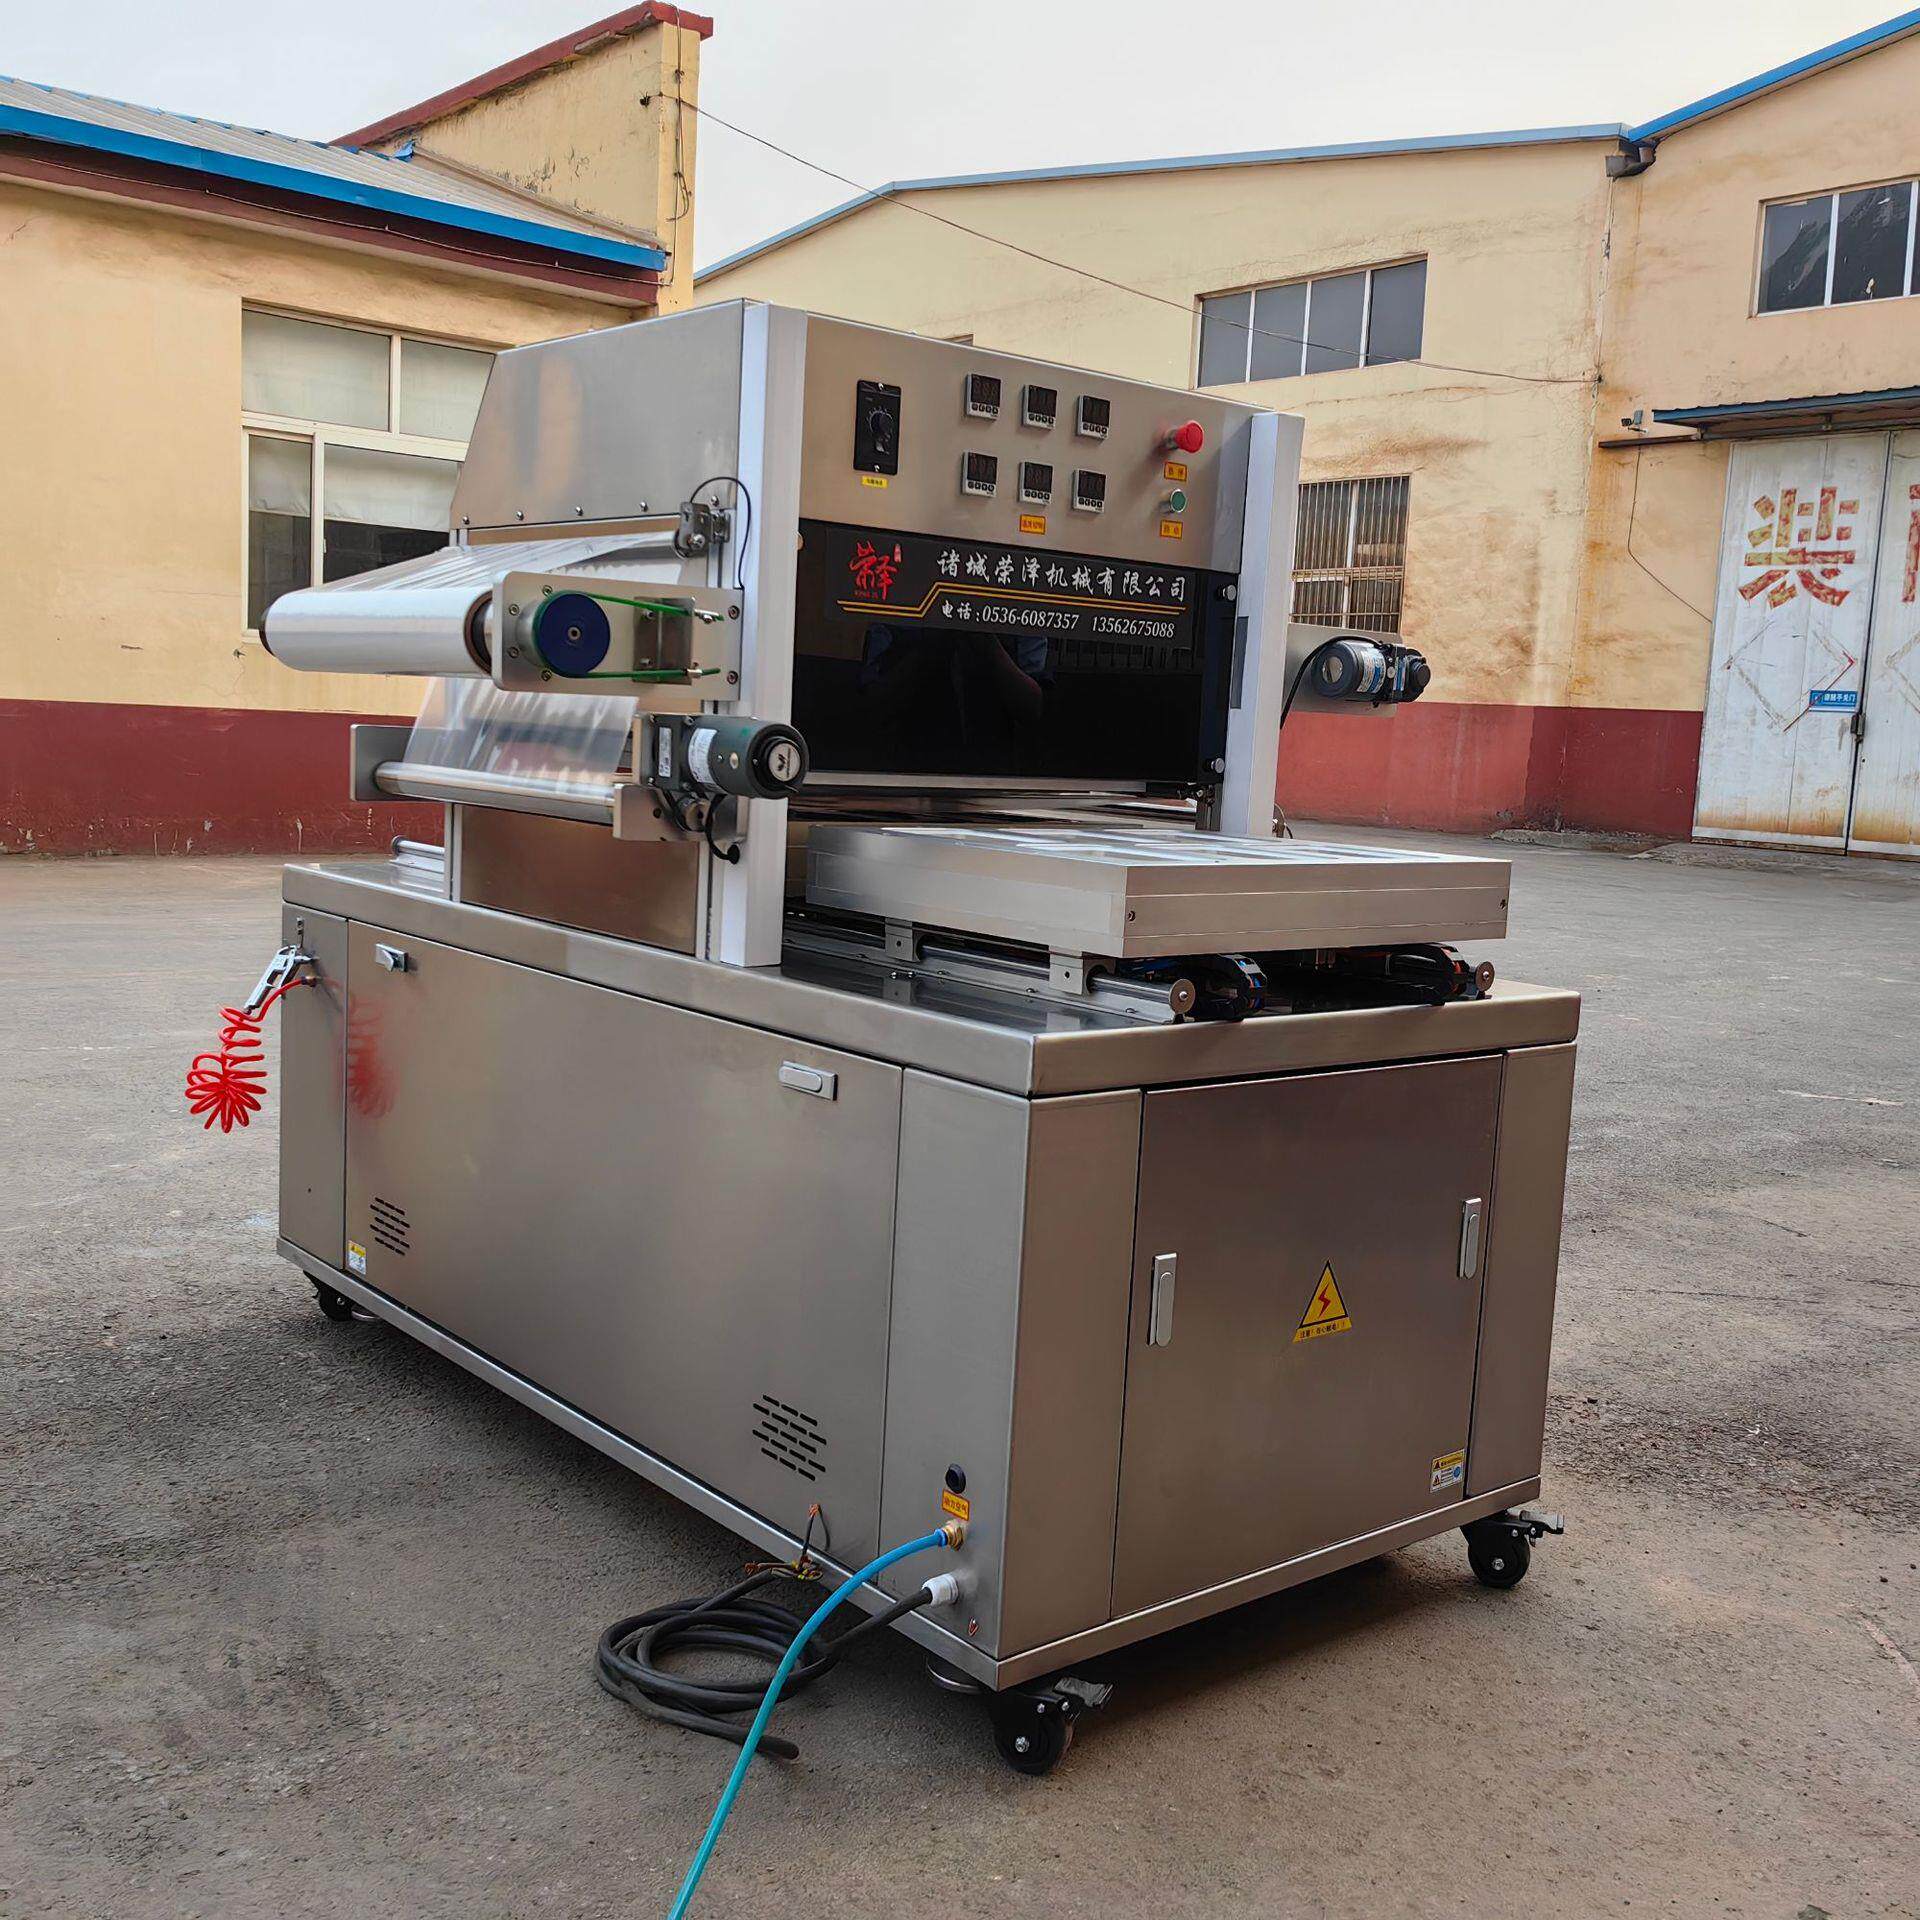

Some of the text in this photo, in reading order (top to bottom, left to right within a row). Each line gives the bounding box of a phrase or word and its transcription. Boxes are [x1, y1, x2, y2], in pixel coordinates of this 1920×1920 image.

[1738, 485, 1920, 609] 装
[936, 550, 1187, 602] 诸城荣泽机械有限公司
[1091, 616, 1176, 639] 13562675088
